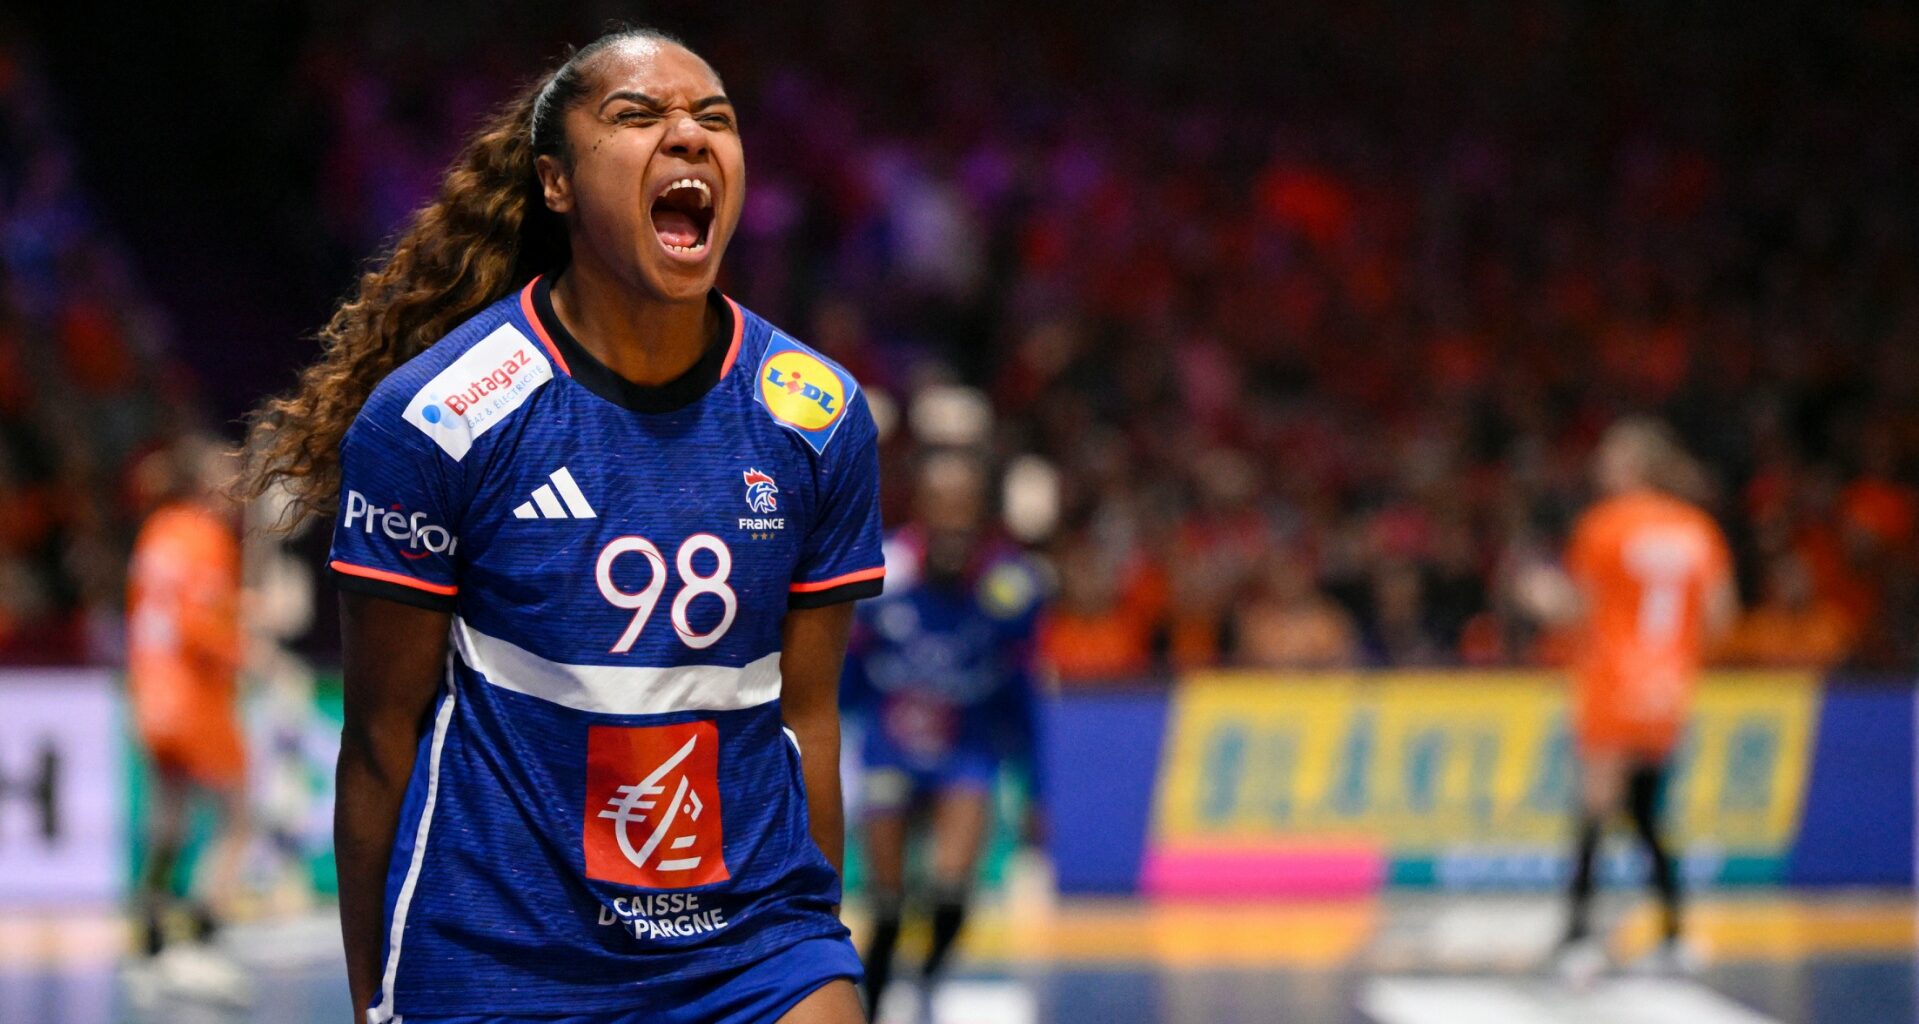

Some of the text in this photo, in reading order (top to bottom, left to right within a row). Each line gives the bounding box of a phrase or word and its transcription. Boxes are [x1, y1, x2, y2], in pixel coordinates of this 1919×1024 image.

[444, 349, 531, 416] Butagaz
[468, 413, 485, 429] GAZ
[738, 518, 785, 530] FRANCE
[595, 533, 738, 655] 98
[613, 893, 700, 917] CAISSE
